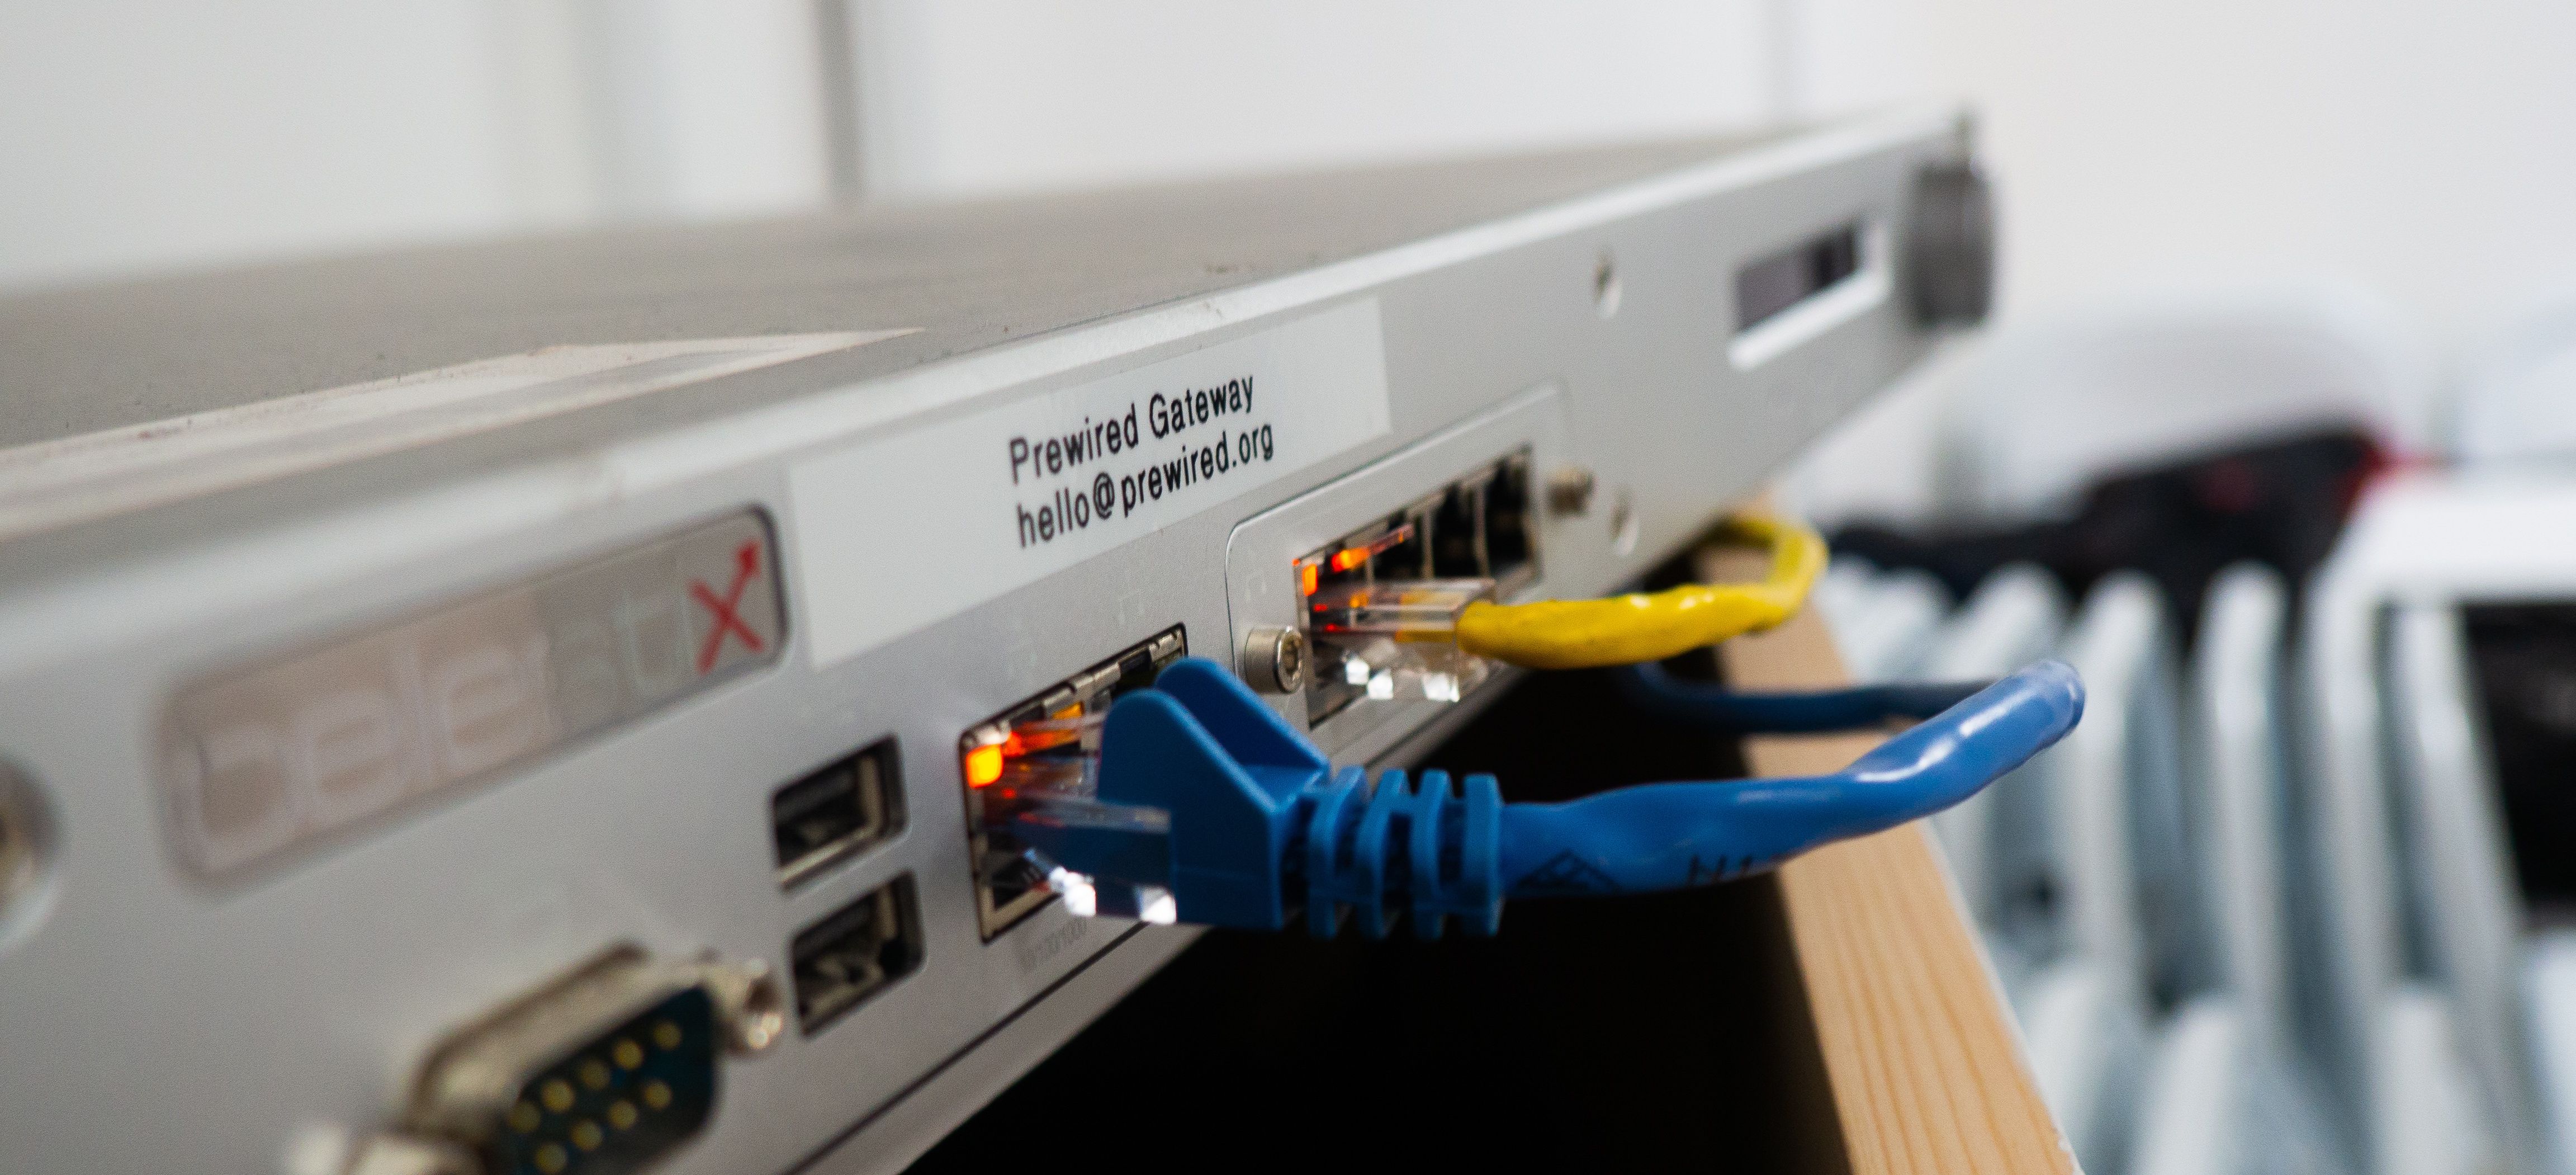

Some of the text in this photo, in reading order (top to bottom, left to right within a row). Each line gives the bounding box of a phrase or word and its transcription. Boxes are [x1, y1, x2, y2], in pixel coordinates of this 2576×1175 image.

[1008, 375, 1253, 485] Prewired Gateway
[1016, 423, 1275, 548] hello@prewired.org
